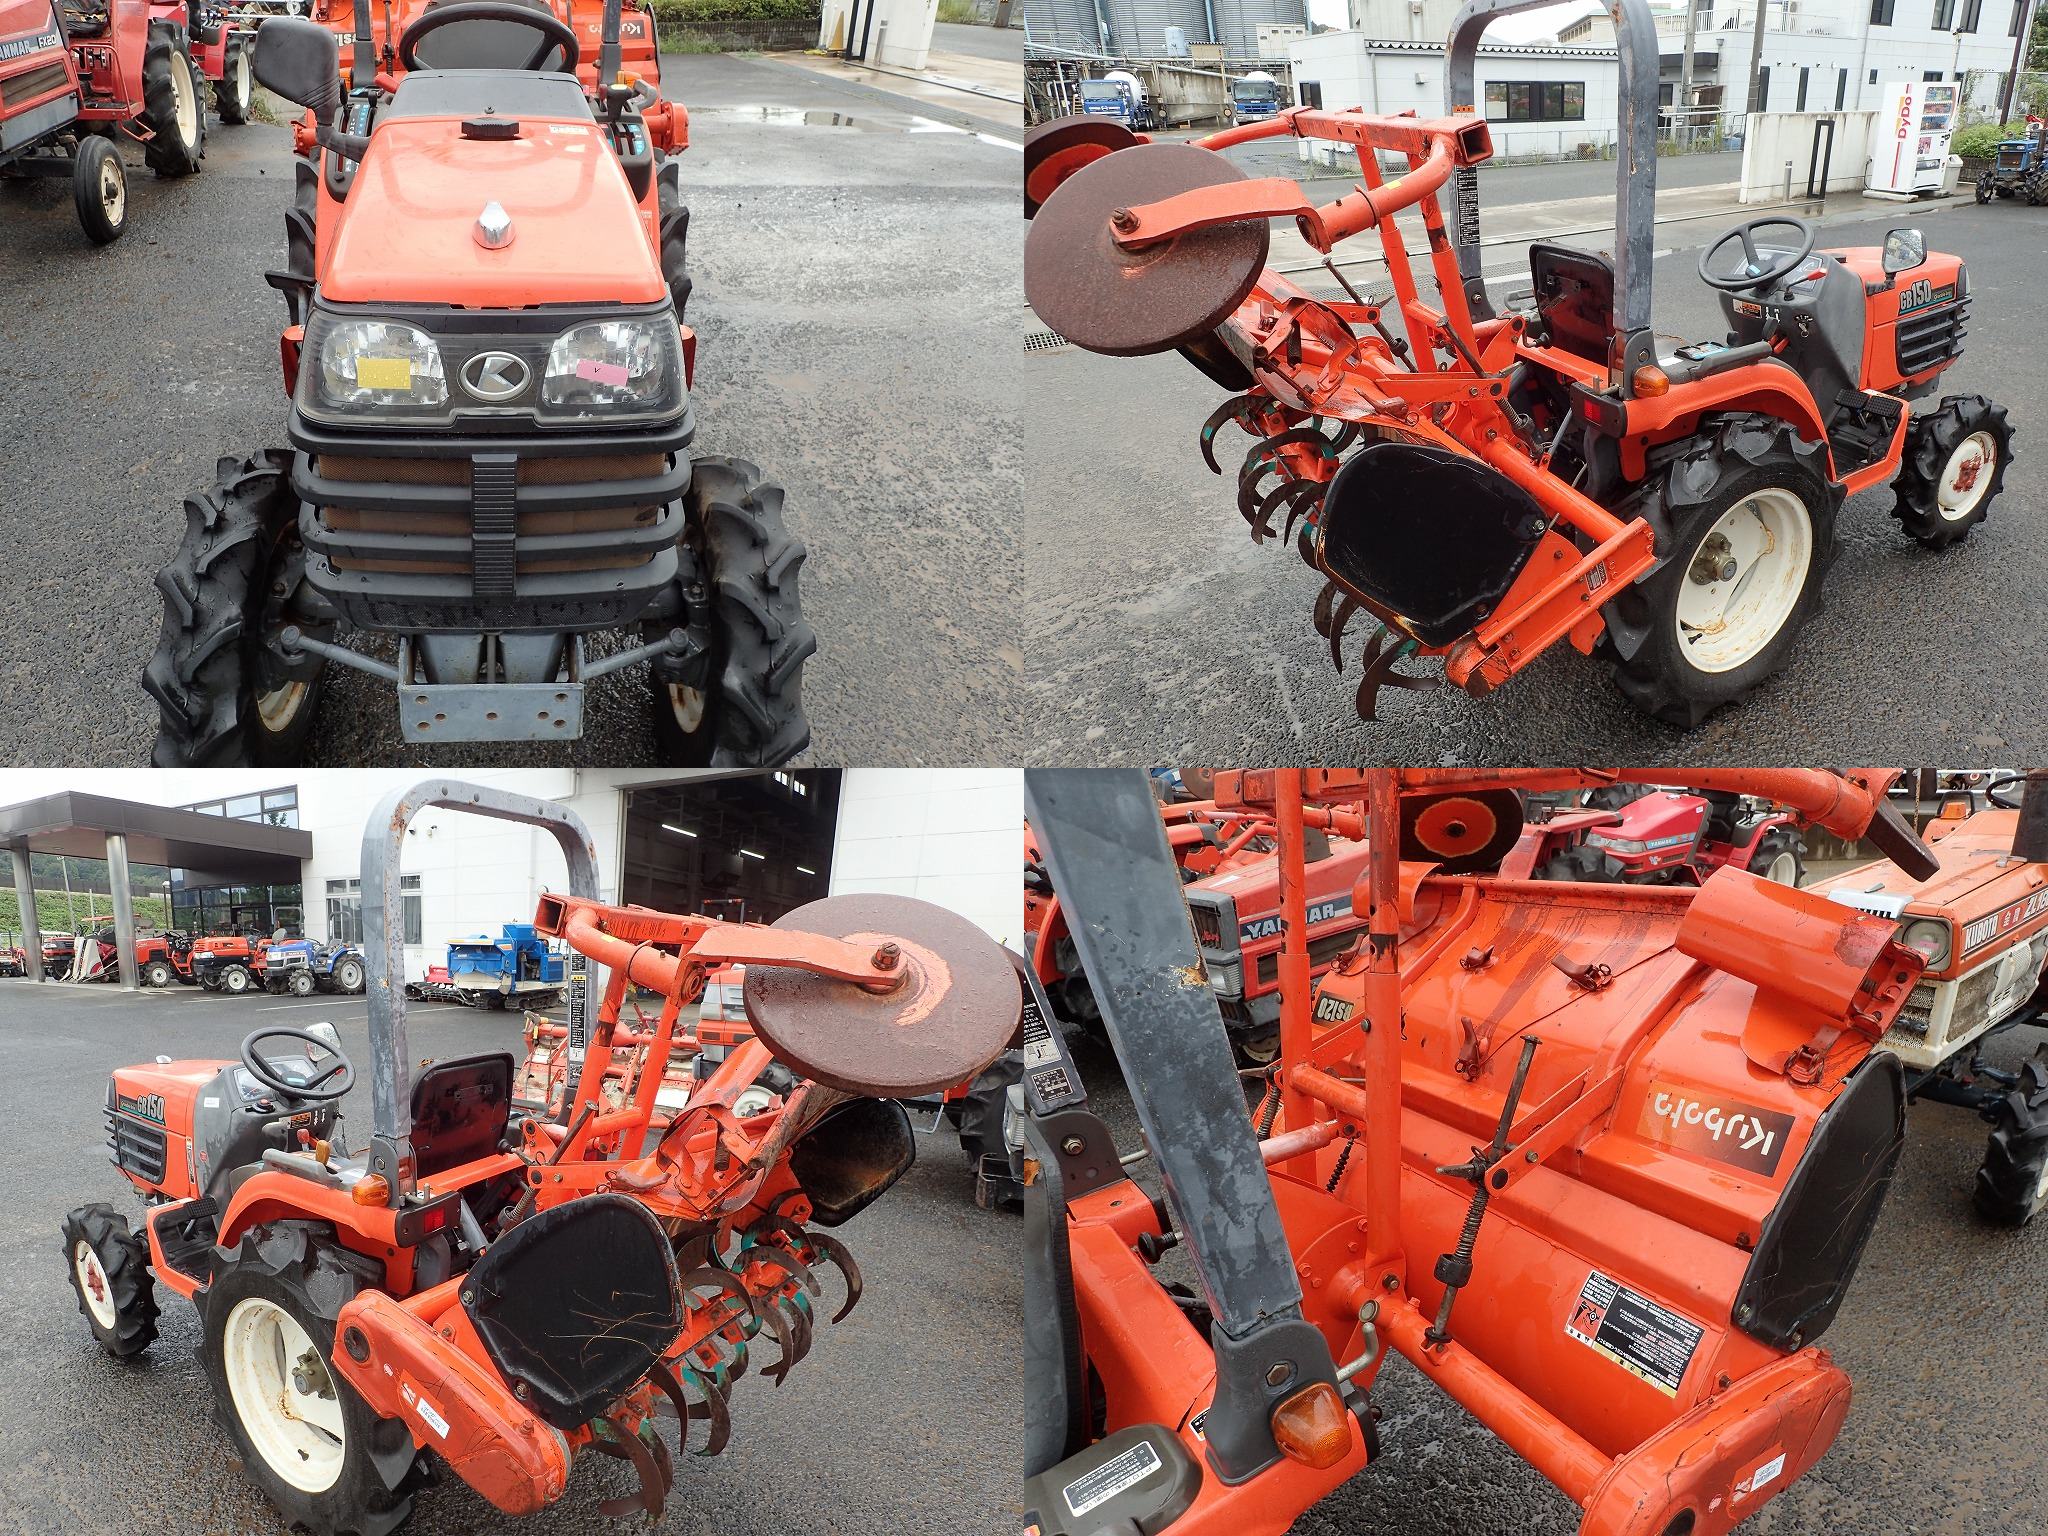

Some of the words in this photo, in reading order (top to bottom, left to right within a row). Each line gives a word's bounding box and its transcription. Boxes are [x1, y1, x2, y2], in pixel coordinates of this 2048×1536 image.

[38, 34, 57, 48] FX20
[1897, 96, 1912, 139] DyDo
[1899, 279, 1932, 311] GB150
[1246, 903, 1335, 940] YAAR
[1964, 914, 1999, 951] KUBOTA
[137, 1093, 165, 1120] GB150
[1654, 1092, 1776, 1156] Kubota
